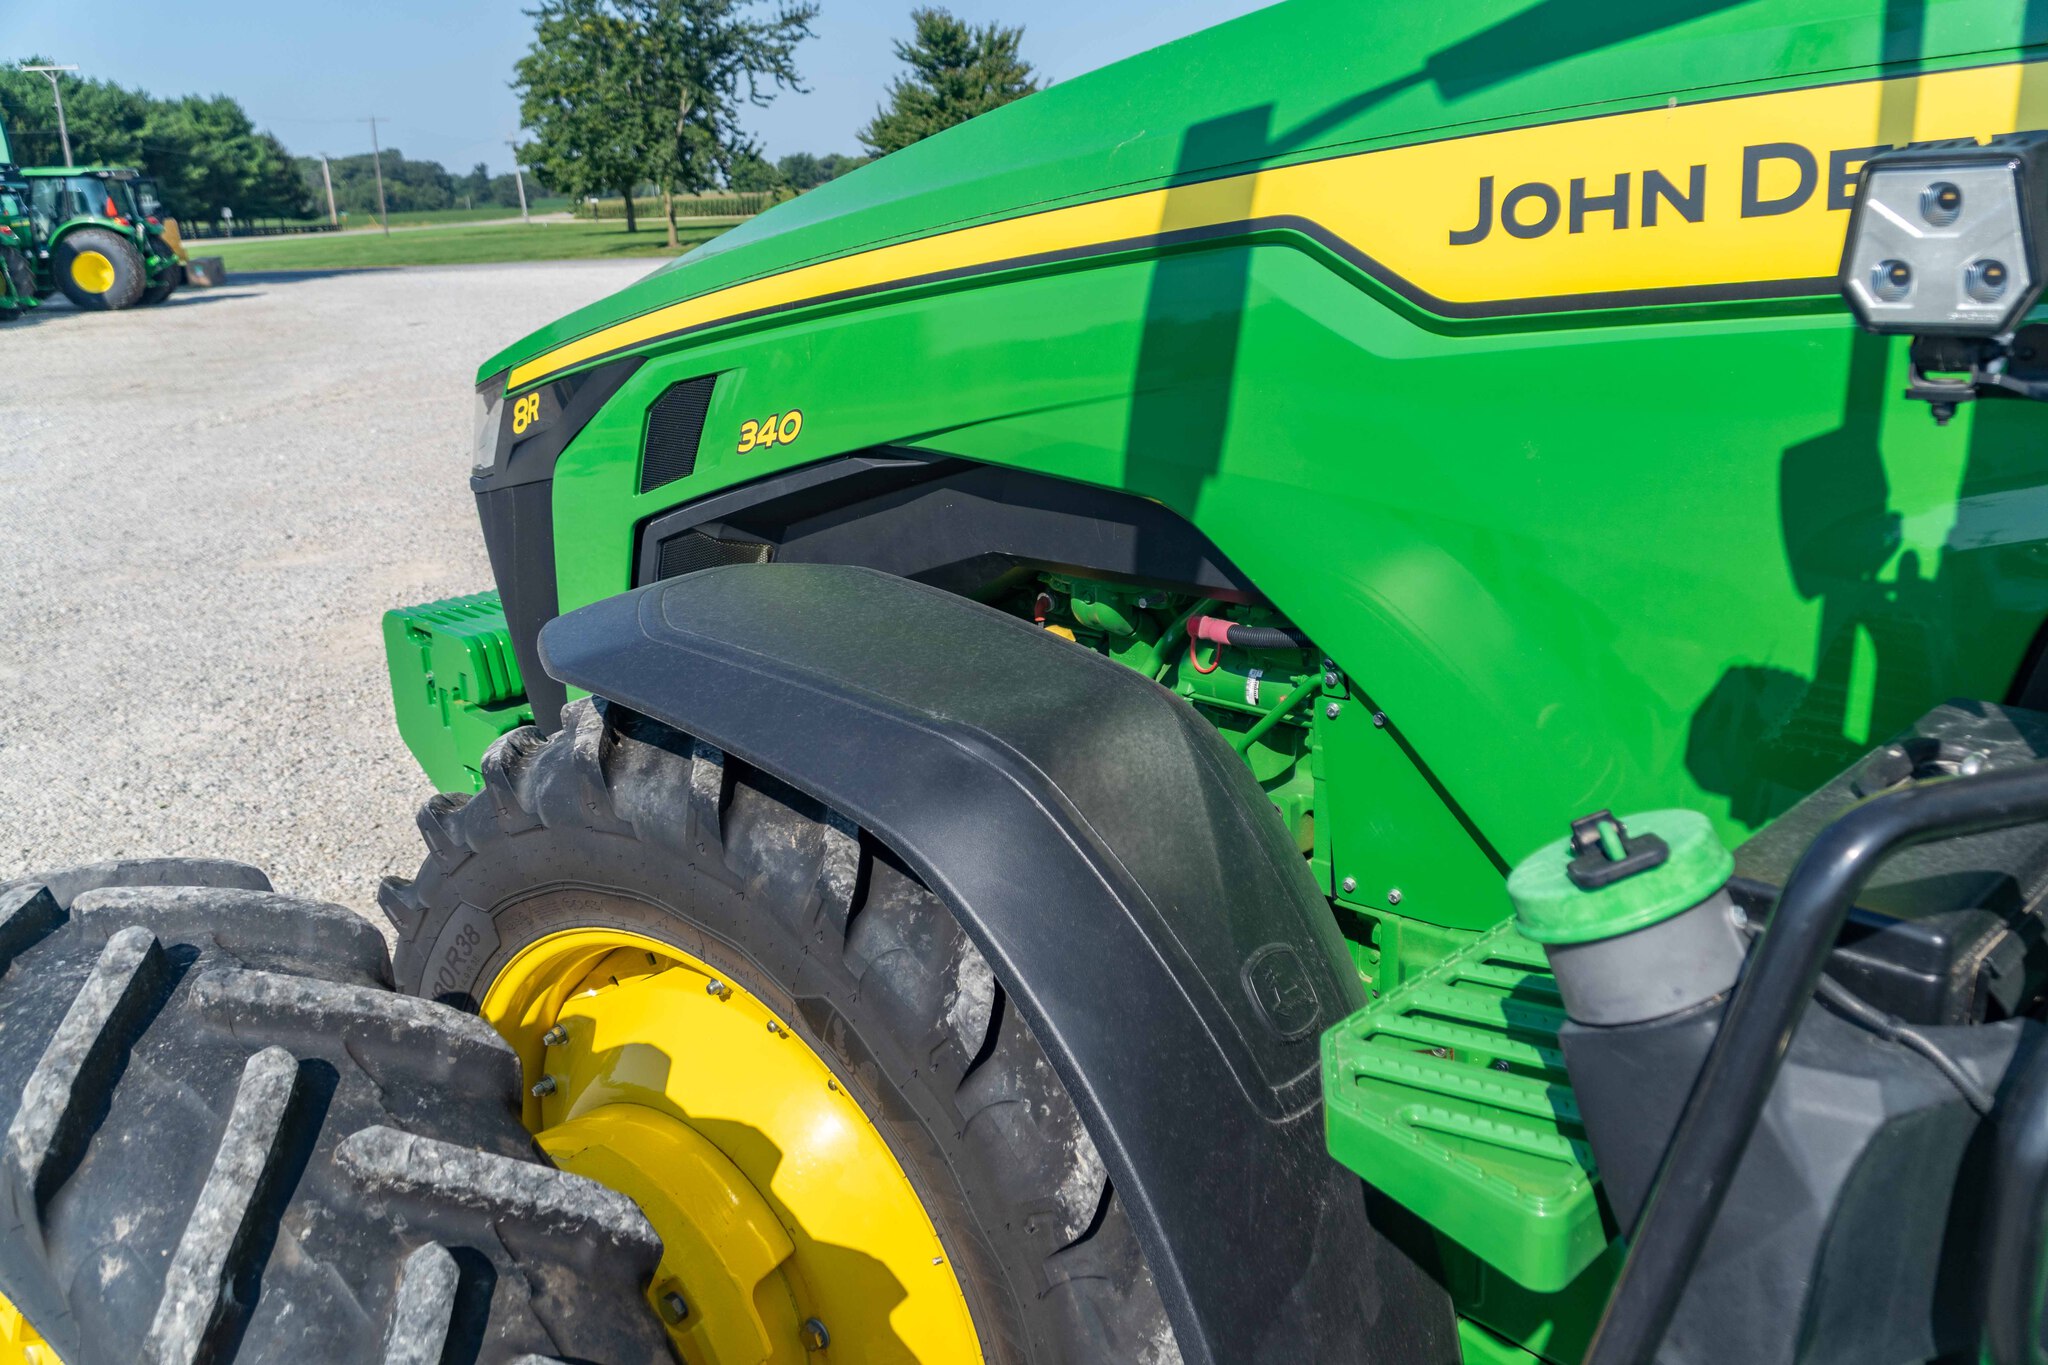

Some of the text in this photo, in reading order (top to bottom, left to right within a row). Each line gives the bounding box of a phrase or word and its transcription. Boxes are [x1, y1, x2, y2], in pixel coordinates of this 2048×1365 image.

[1449, 142, 1869, 246] JOHN DE
[513, 392, 540, 434] 8R
[737, 409, 804, 455] 340
